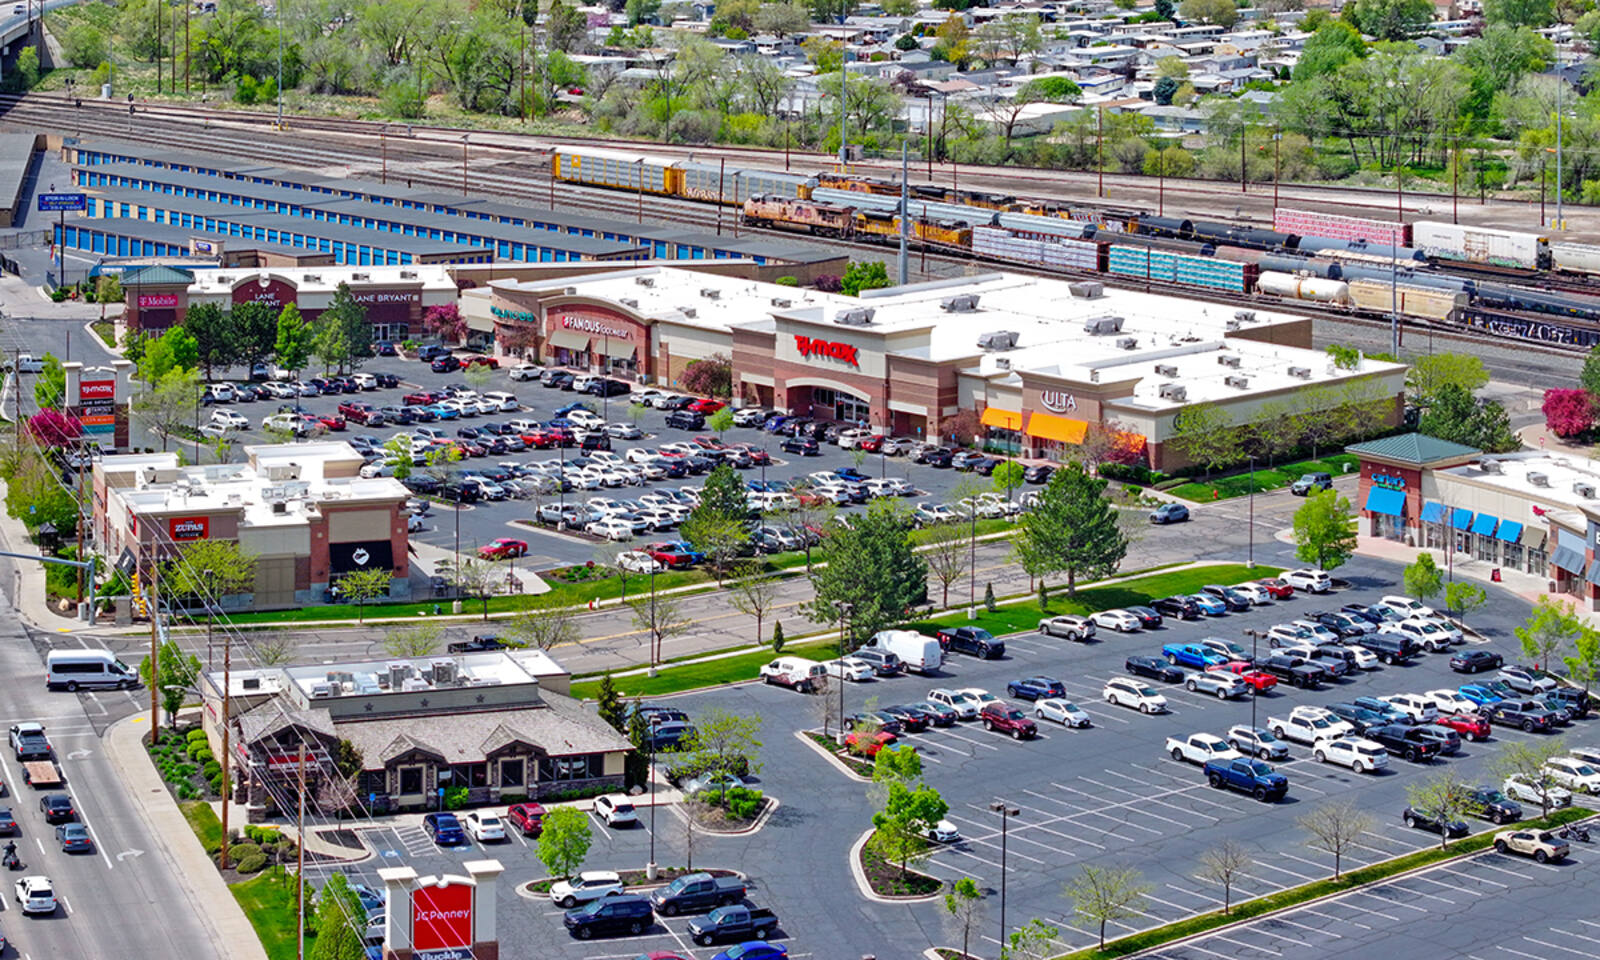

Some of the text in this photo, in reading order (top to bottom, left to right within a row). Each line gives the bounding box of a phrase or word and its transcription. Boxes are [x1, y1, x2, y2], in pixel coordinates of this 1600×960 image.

[351, 294, 412, 302] LANE BRYANT
[569, 316, 601, 333] FAMOUS
[1043, 390, 1077, 409] ULTA
